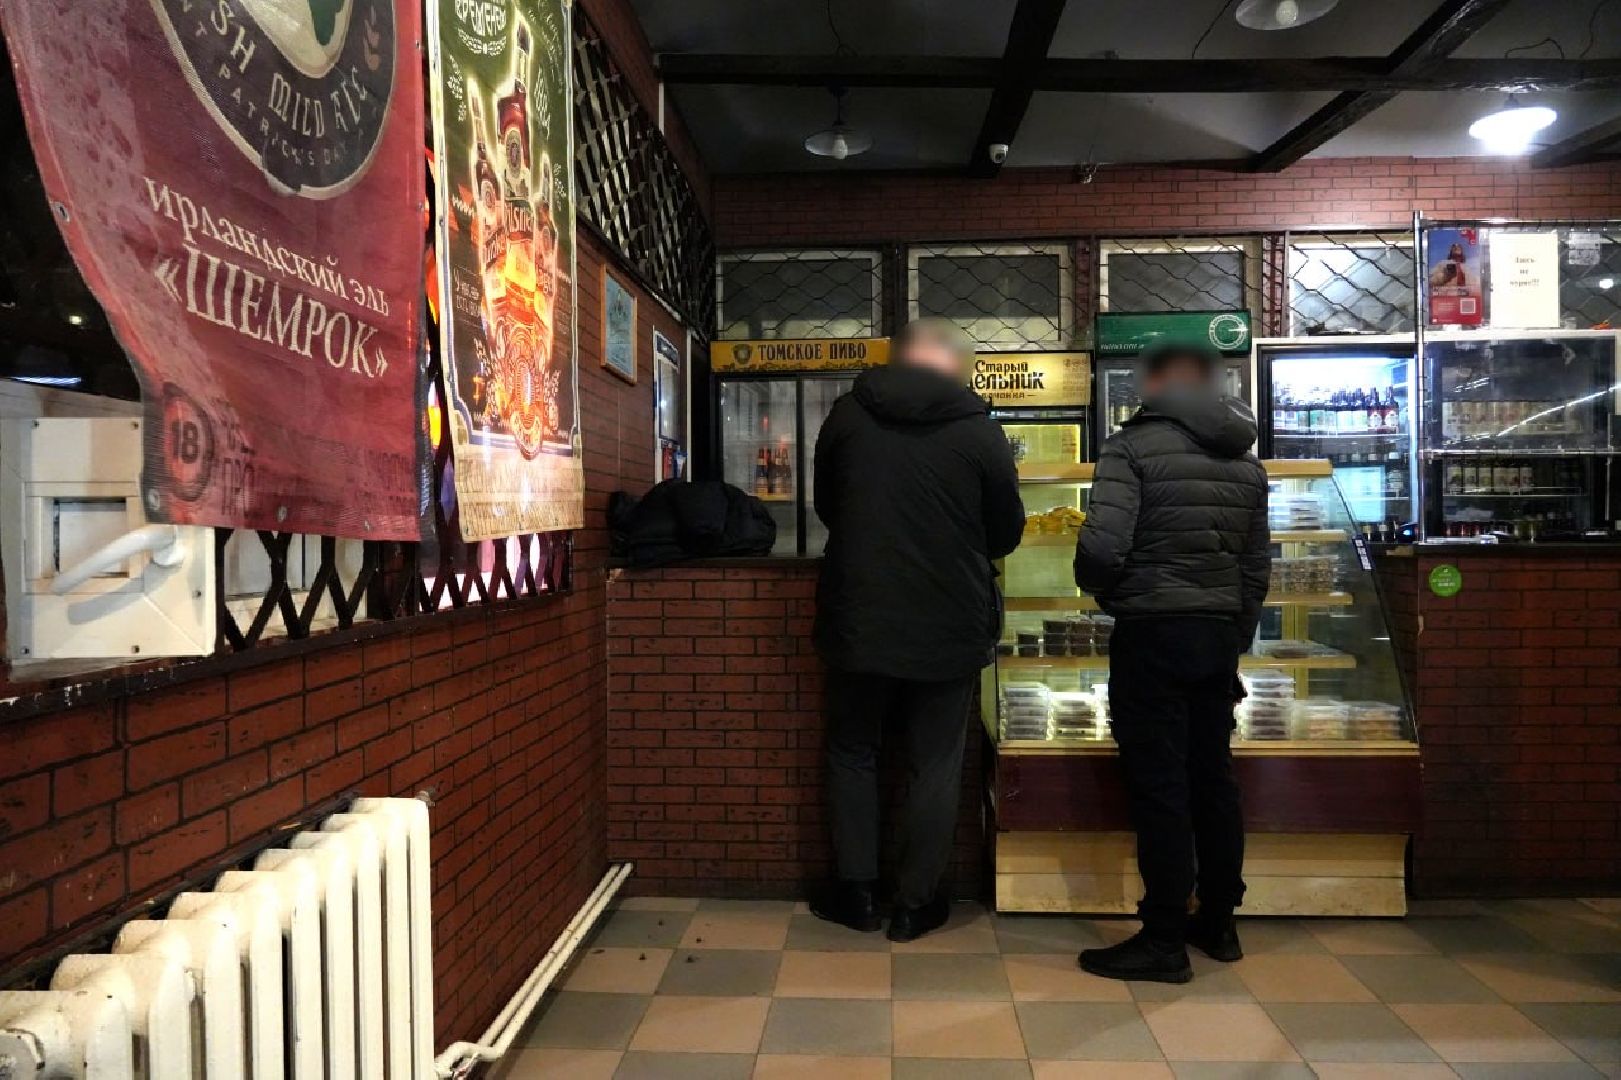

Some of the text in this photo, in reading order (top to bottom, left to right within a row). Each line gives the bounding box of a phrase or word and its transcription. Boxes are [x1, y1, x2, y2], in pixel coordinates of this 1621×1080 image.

[268, 72, 325, 138] MILD
[154, 243, 389, 378] «ШЕМРОК»
[349, 278, 389, 316] эль
[758, 342, 867, 361] ТОМСКОЕ ПИВО
[970, 371, 1045, 390] ельник
[975, 359, 1028, 376] Старый
